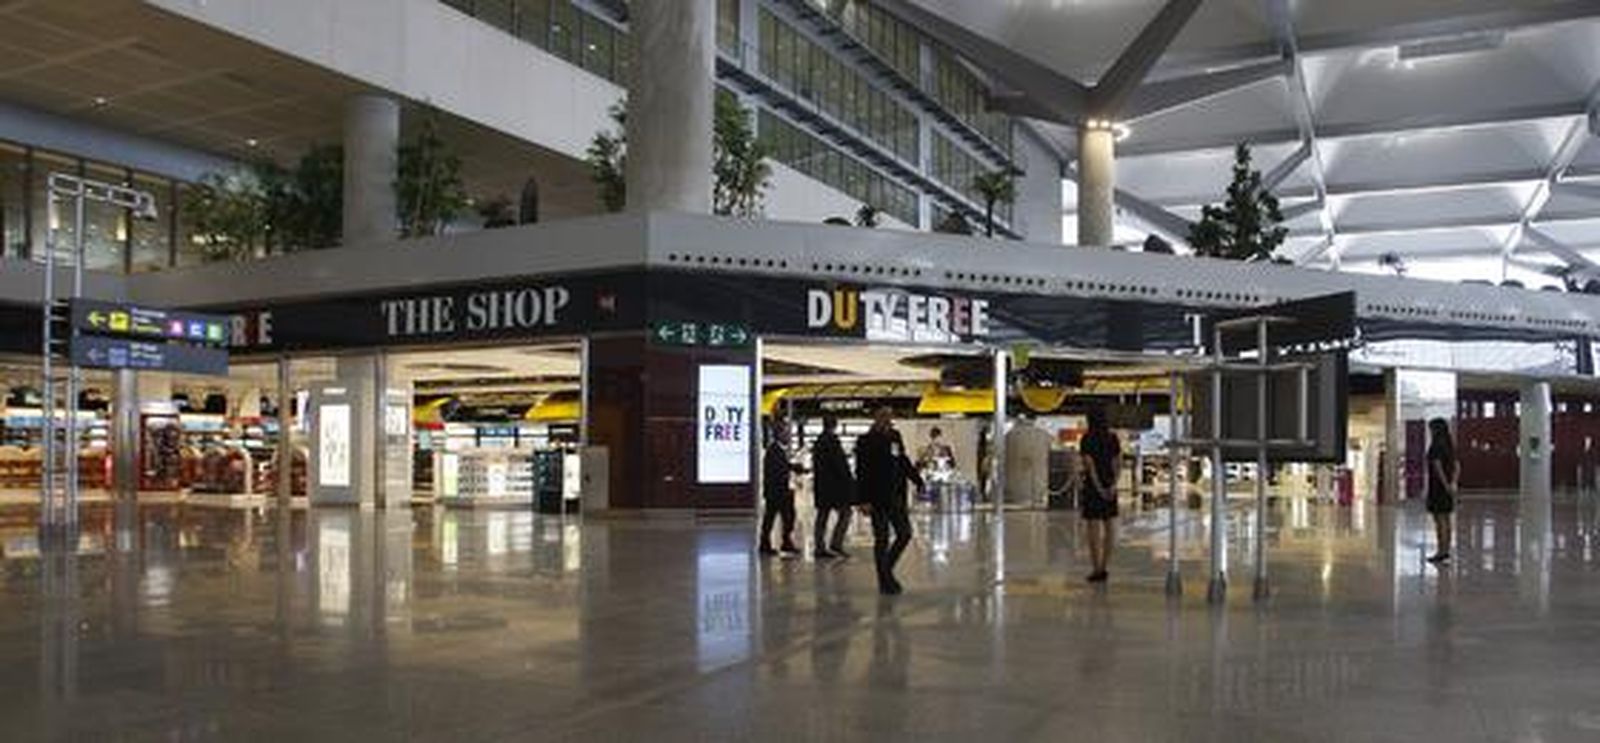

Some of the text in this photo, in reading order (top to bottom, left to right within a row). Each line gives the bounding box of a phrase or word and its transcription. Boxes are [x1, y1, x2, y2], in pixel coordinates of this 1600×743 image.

[382, 297, 455, 336] THE
[467, 286, 570, 331] SHOP
[808, 289, 990, 336] DUTY FREE
[704, 405, 745, 422] DTY
[704, 423, 741, 441] FREE
